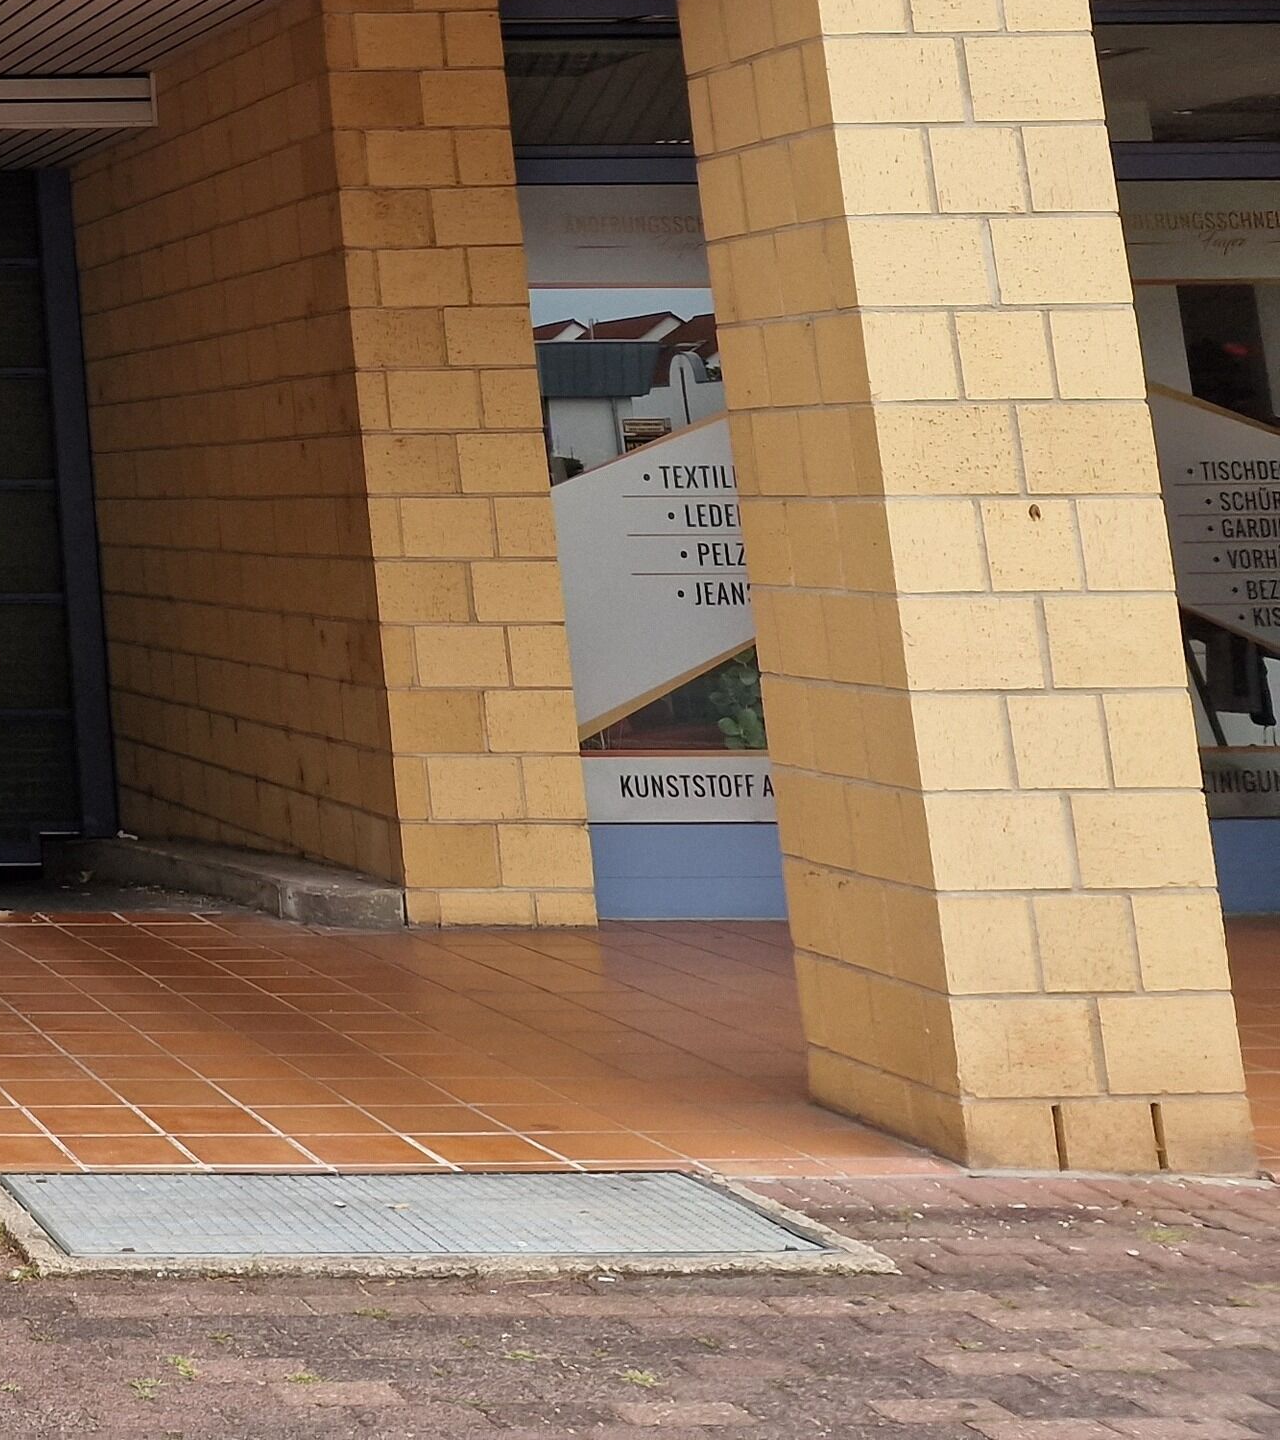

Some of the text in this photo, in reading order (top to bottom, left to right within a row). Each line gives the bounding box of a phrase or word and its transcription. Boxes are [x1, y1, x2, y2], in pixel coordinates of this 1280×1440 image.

[1199, 460, 1280, 481] TISCHDE
[684, 504, 742, 527] LEDE
[1221, 519, 1280, 538] GARDI
[697, 543, 747, 566] PELZ
[1226, 546, 1280, 569] VORH
[619, 774, 755, 798] KUNSTSTOFF
